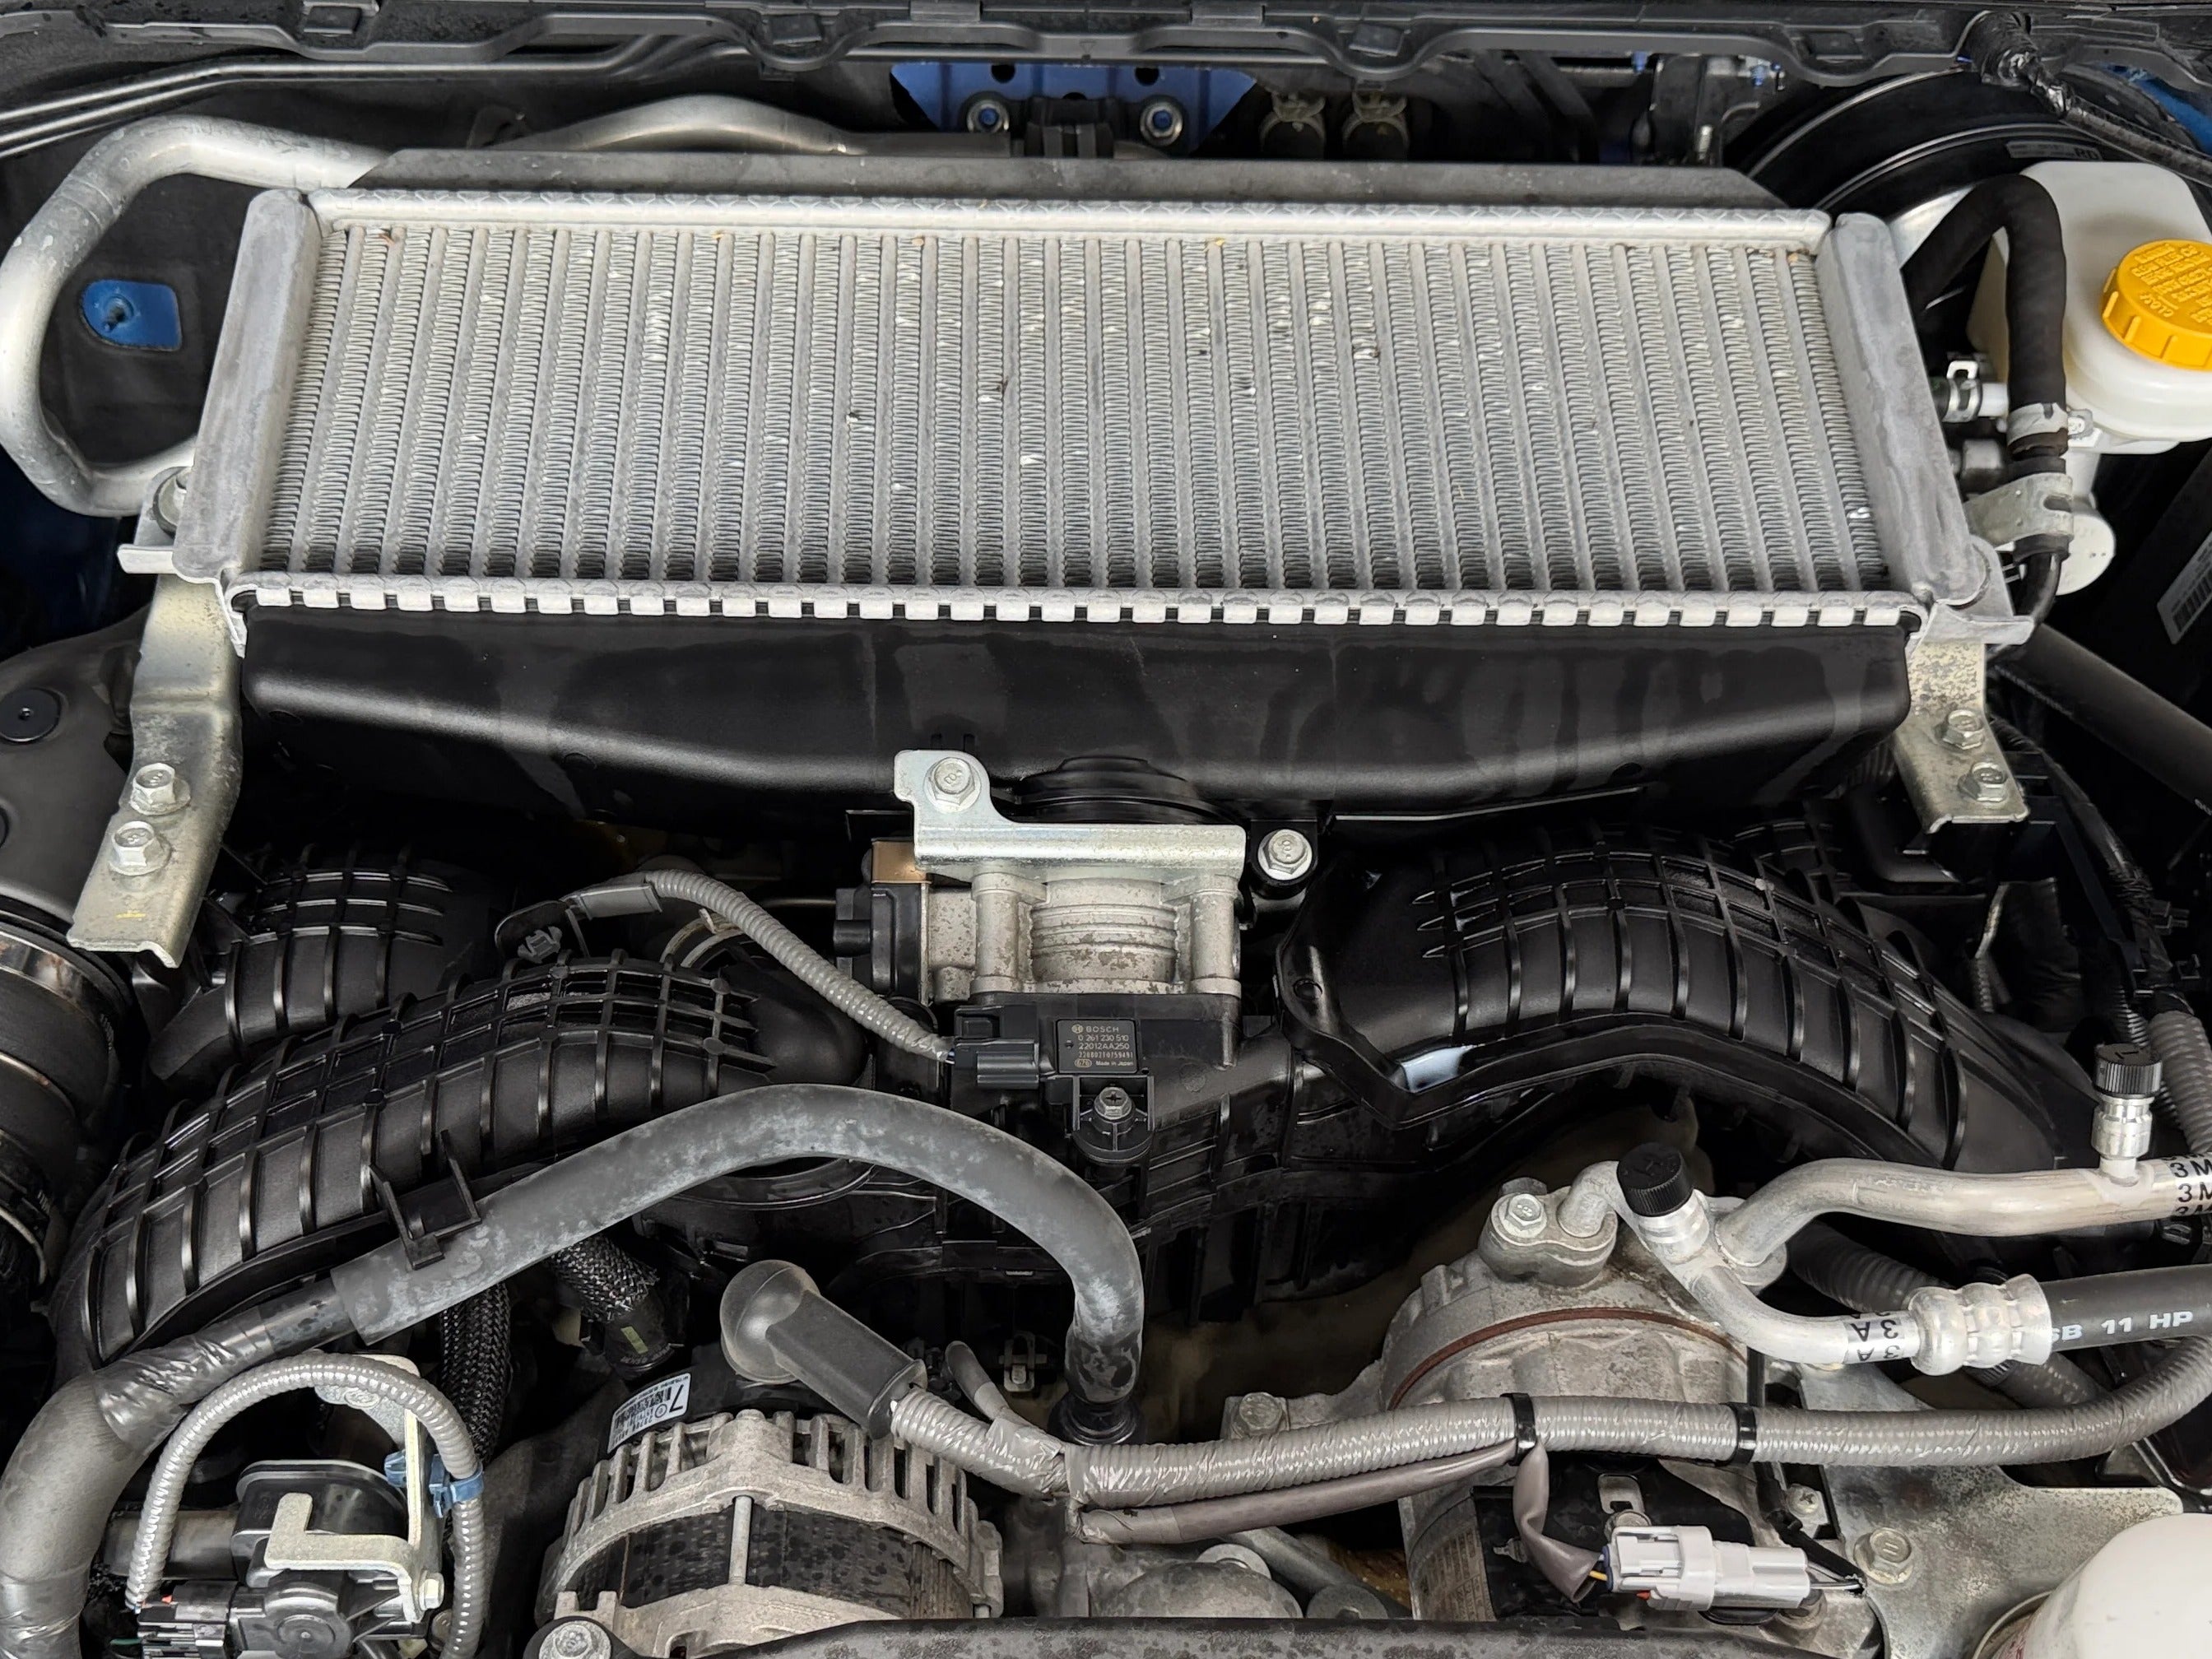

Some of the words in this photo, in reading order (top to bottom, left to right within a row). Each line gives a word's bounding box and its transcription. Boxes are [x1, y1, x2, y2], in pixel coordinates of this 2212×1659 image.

[1085, 1025, 1119, 1034] BOSCH
[2169, 1162, 2189, 1178] 3
[2177, 1183, 2193, 1203] 3
[1850, 1321, 1871, 1342] A
[1880, 1319, 1899, 1340] 3
[2101, 1317, 2132, 1335] 11
[2149, 1311, 2193, 1329] HP
[669, 1384, 684, 1413] 7
